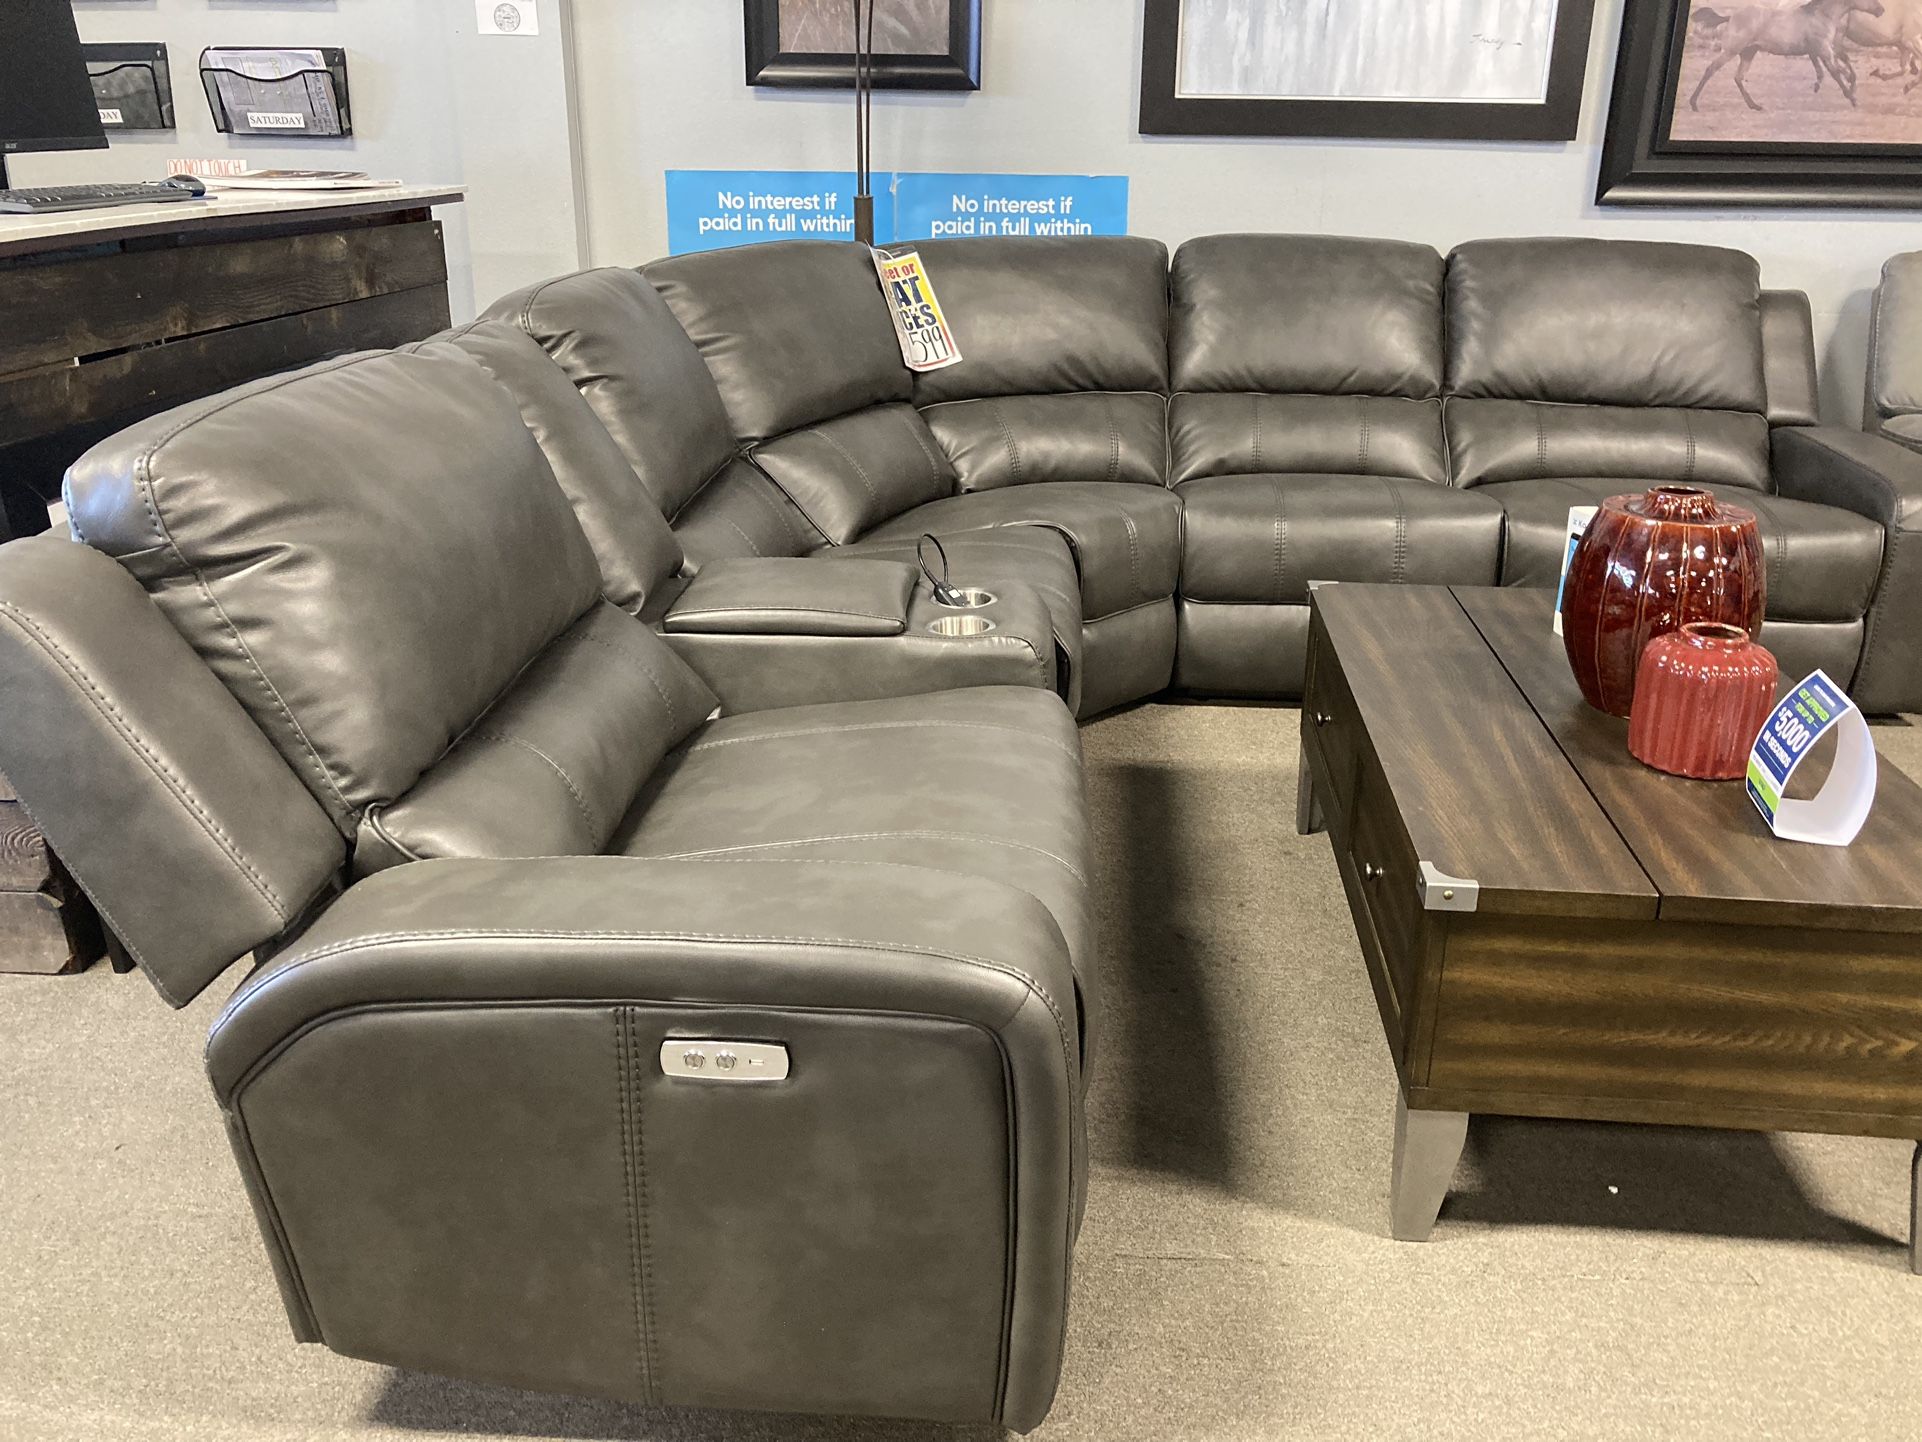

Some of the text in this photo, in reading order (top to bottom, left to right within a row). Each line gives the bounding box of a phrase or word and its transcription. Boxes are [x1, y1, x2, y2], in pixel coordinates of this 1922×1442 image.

[249, 115, 302, 125] SATURDAY
[169, 160, 183, 175] DO
[184, 159, 205, 175] NOT
[718, 191, 838, 210] No interest if
[952, 195, 1073, 214] No interest if
[698, 213, 742, 234] paid
[747, 214, 763, 231] in
[767, 214, 796, 232] full
[931, 217, 1092, 238] paid in full within
[901, 263, 916, 277] or
[1763, 730, 1772, 743] IN
[1768, 736, 1792, 768] SECONDS
